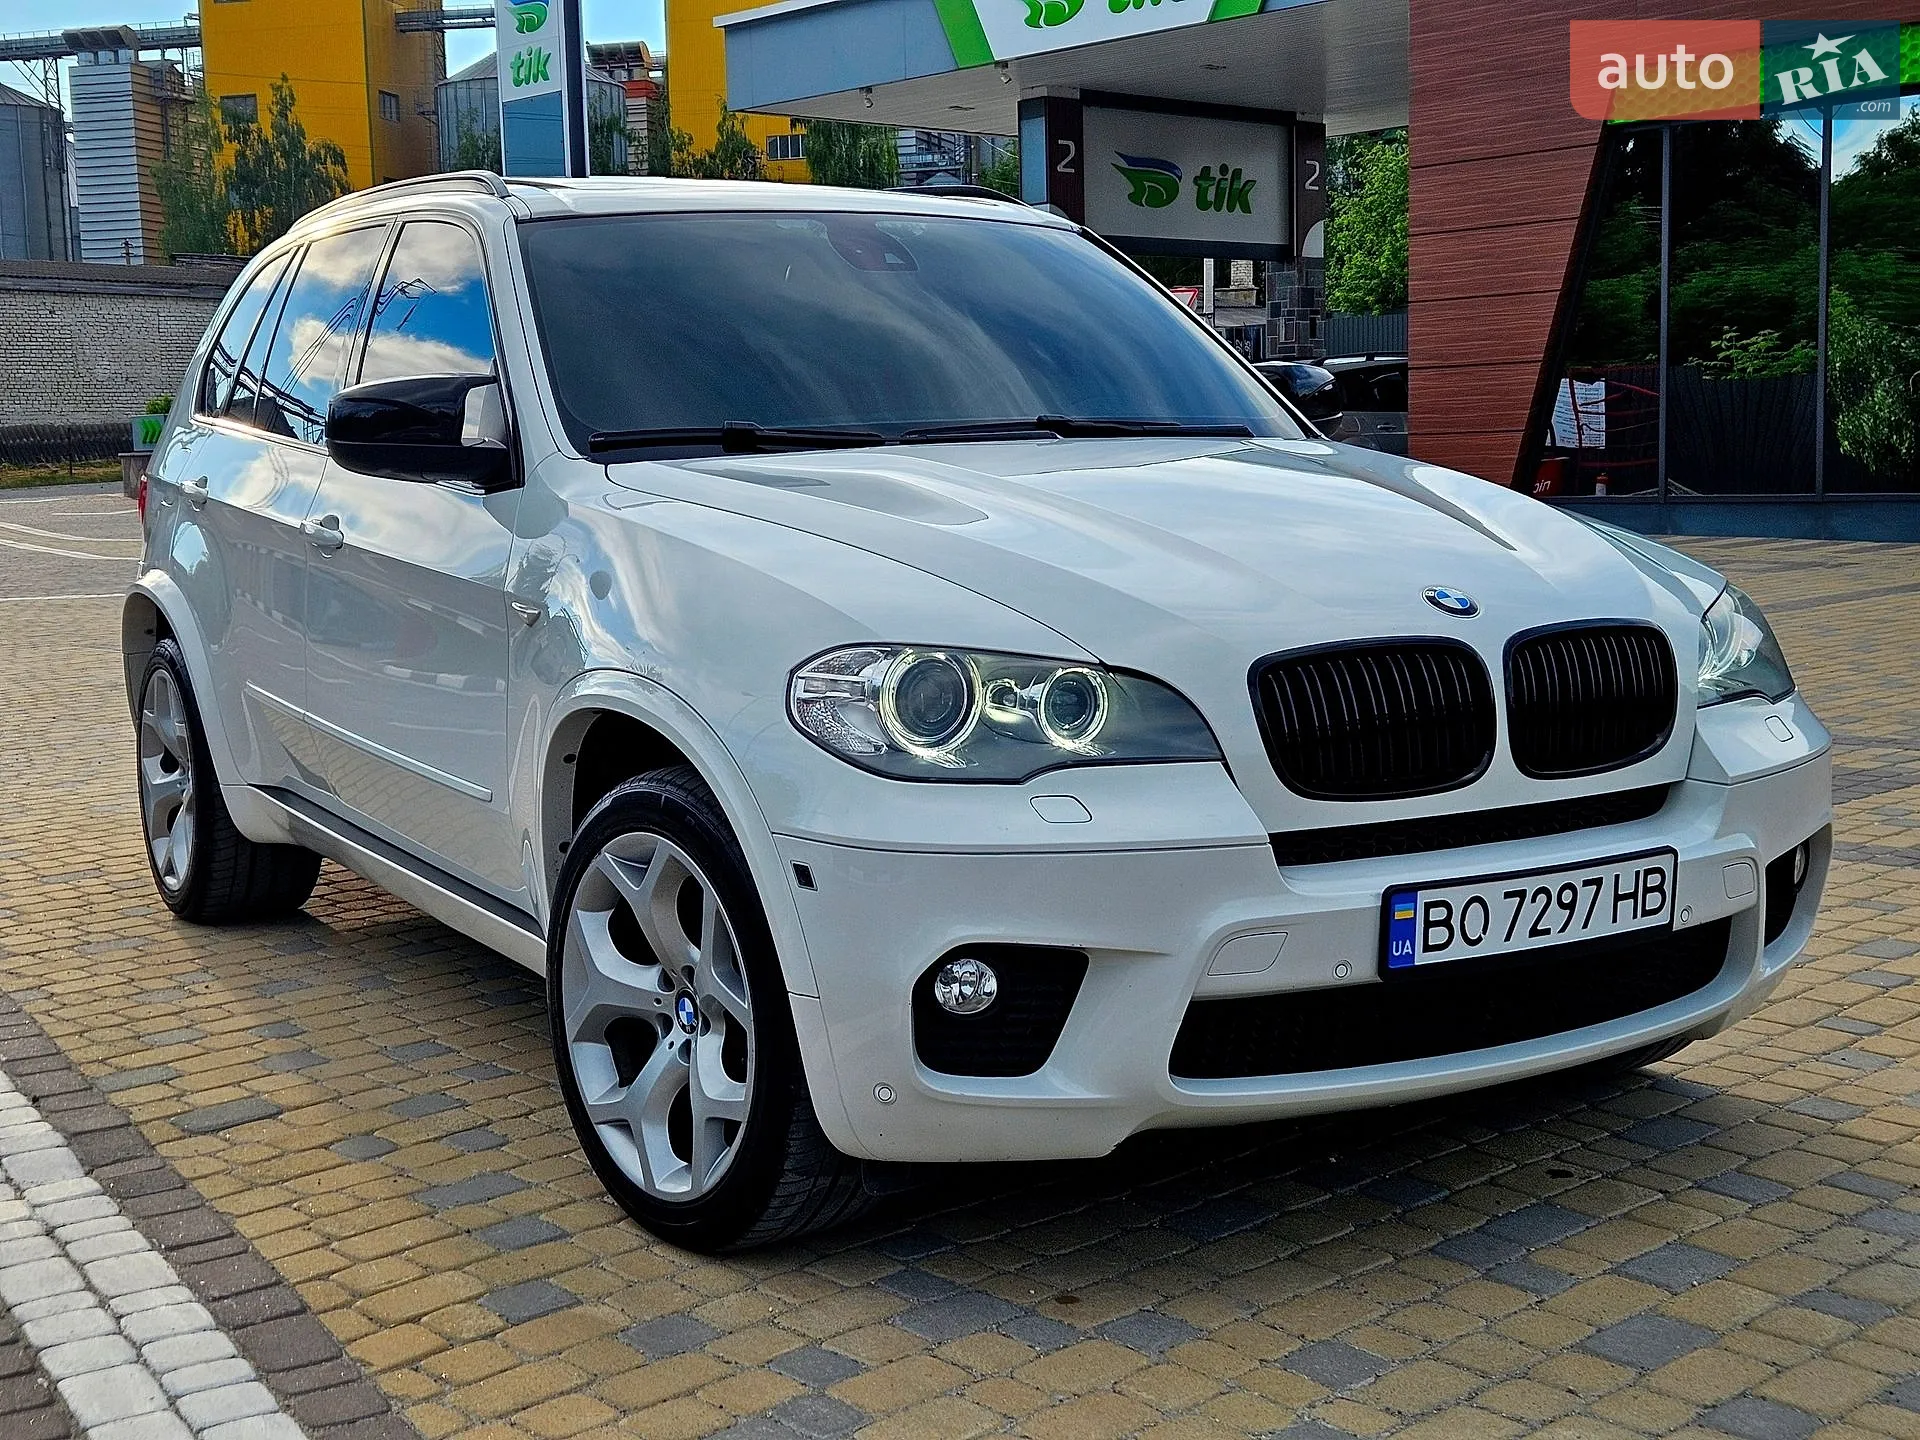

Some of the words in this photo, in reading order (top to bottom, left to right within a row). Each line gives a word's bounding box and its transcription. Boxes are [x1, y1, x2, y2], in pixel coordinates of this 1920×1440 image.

[510, 46, 551, 87] tik
[1057, 139, 1076, 173] 2
[1193, 163, 1256, 214] tik
[1304, 160, 1320, 190] 2
[1422, 895, 1490, 953] BO
[1503, 877, 1604, 942] 7297
[1611, 866, 1668, 924] HB
[1392, 939, 1412, 956] UA
